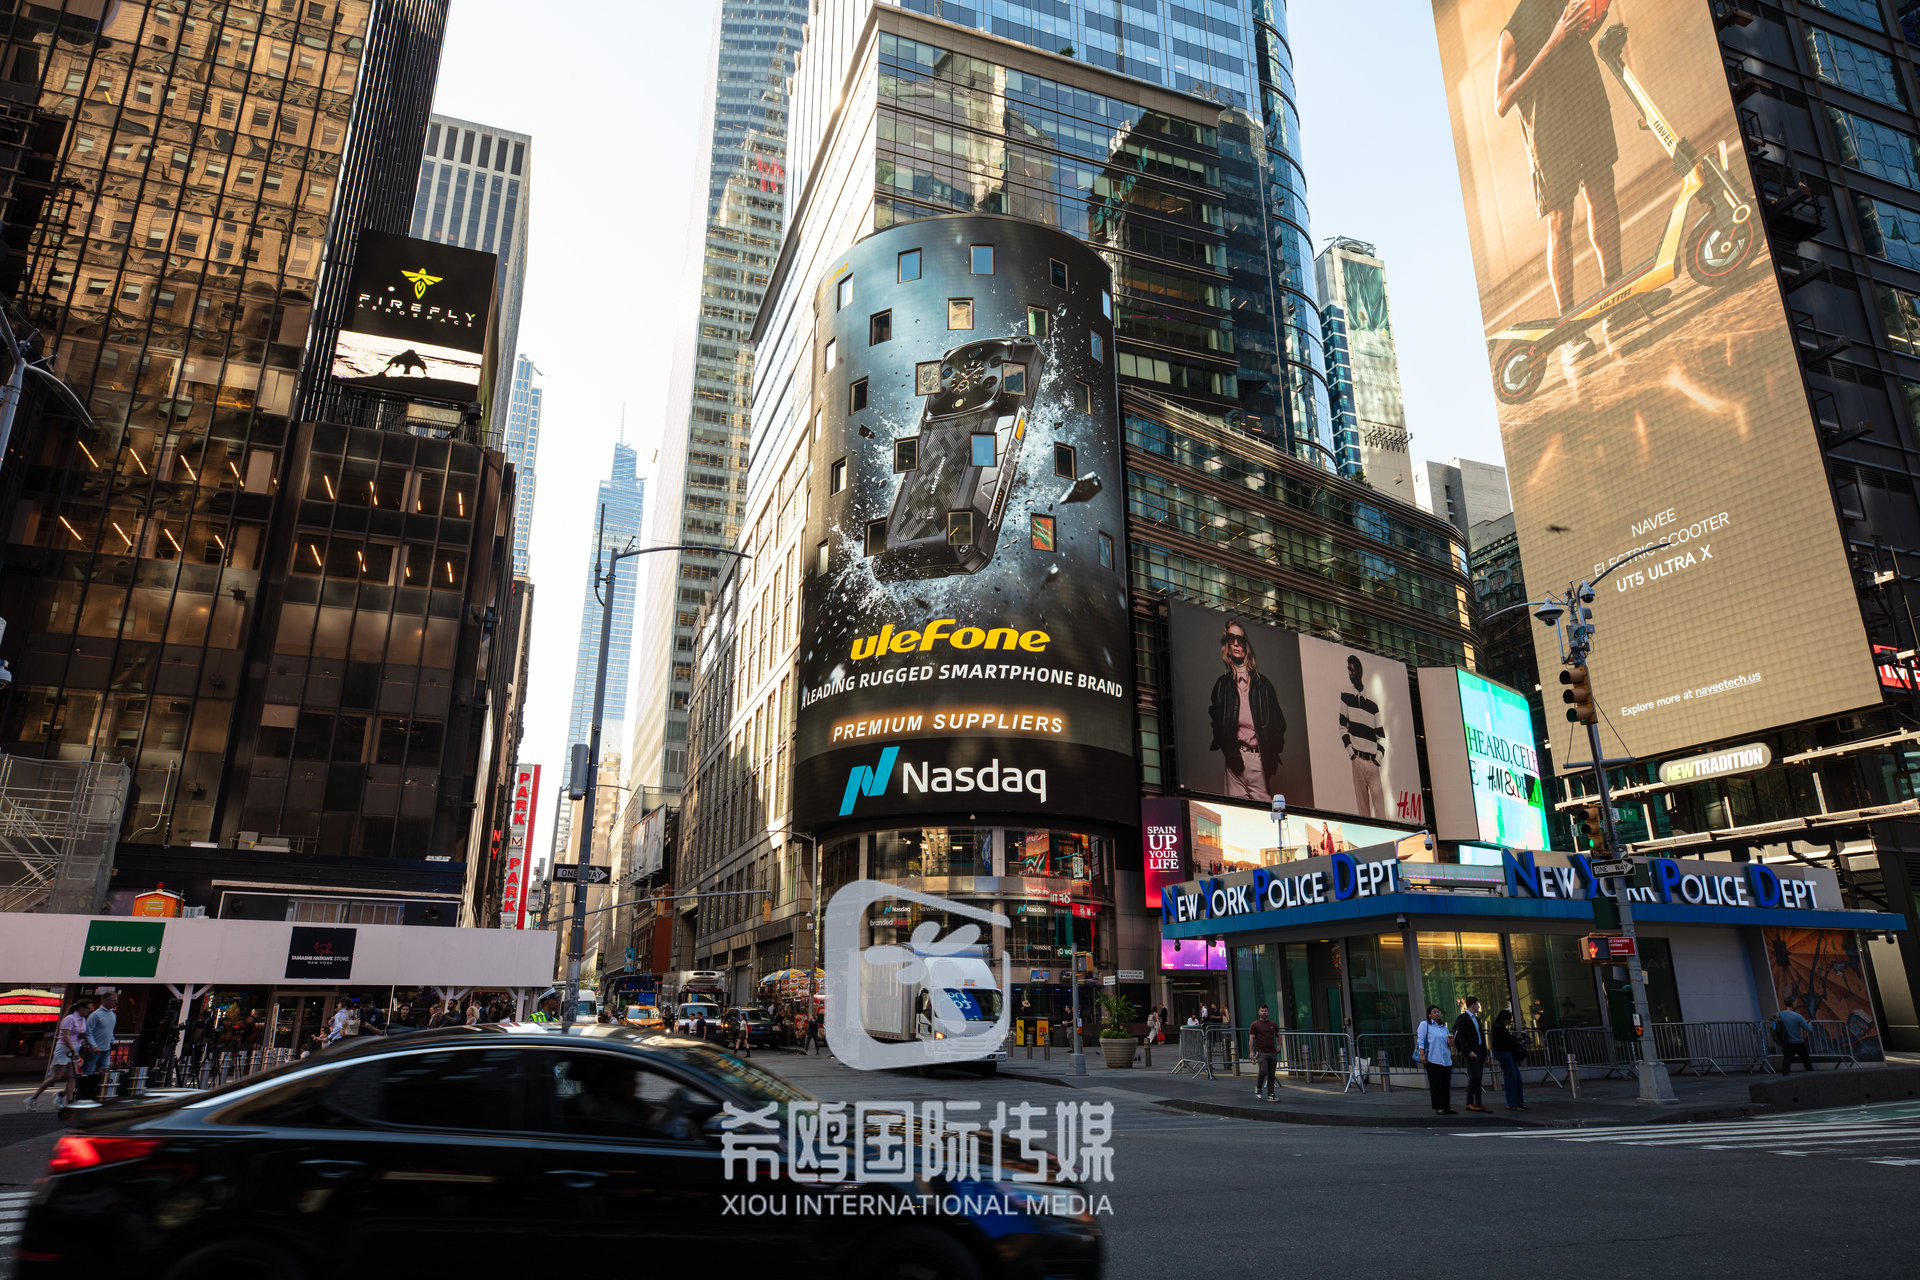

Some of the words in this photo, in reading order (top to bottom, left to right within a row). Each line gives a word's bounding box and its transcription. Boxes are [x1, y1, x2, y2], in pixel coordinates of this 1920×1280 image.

[1653, 120, 1675, 147] NAVEE
[358, 293, 476, 321] FIREFLY
[1599, 287, 1632, 311] ULTRA
[358, 303, 472, 327] AEROSPACE
[1631, 508, 1677, 538] NAVEE
[1594, 542, 1656, 577] ELECTRIC
[1659, 512, 1730, 550] SCOOTER
[1616, 571, 1645, 592] UT5
[1648, 552, 1697, 580] ULTRA
[1700, 544, 1713, 561] X
[806, 675, 856, 706] LEADING
[859, 665, 933, 689] RUGGED
[938, 664, 1074, 686] SMARTPHONE
[1077, 673, 1123, 698] BRAND
[1621, 701, 1655, 716] Explore
[1656, 694, 1681, 707] more
[1683, 690, 1693, 700] at
[1695, 672, 1762, 698] naveetech.us
[833, 715, 923, 742] PREMIUM
[933, 713, 1063, 733] SUPPLIERS
[902, 758, 1047, 803] Nasdaq
[513, 772, 531, 825] PARK
[1397, 790, 1422, 822] H&M
[1147, 826, 1176, 834] SPAIN
[1148, 834, 1178, 850] UP
[1149, 850, 1179, 859] YOUR
[1149, 859, 1179, 869] LIFE
[1595, 865, 1609, 873] ONE
[1615, 863, 1628, 871] WAY
[503, 858, 521, 913] PARK
[561, 869, 578, 877] ONE
[1502, 848, 1576, 898] NEW
[1654, 858, 1750, 906] POLICE
[1747, 864, 1818, 909] DEPT
[1161, 885, 1199, 924] NEW
[1199, 878, 1251, 919] YORK
[1253, 868, 1327, 912] POLICE
[1331, 853, 1398, 900] DEPT
[1026, 906, 1047, 914] Nasdaq
[89, 945, 142, 953] STARBUCKS
